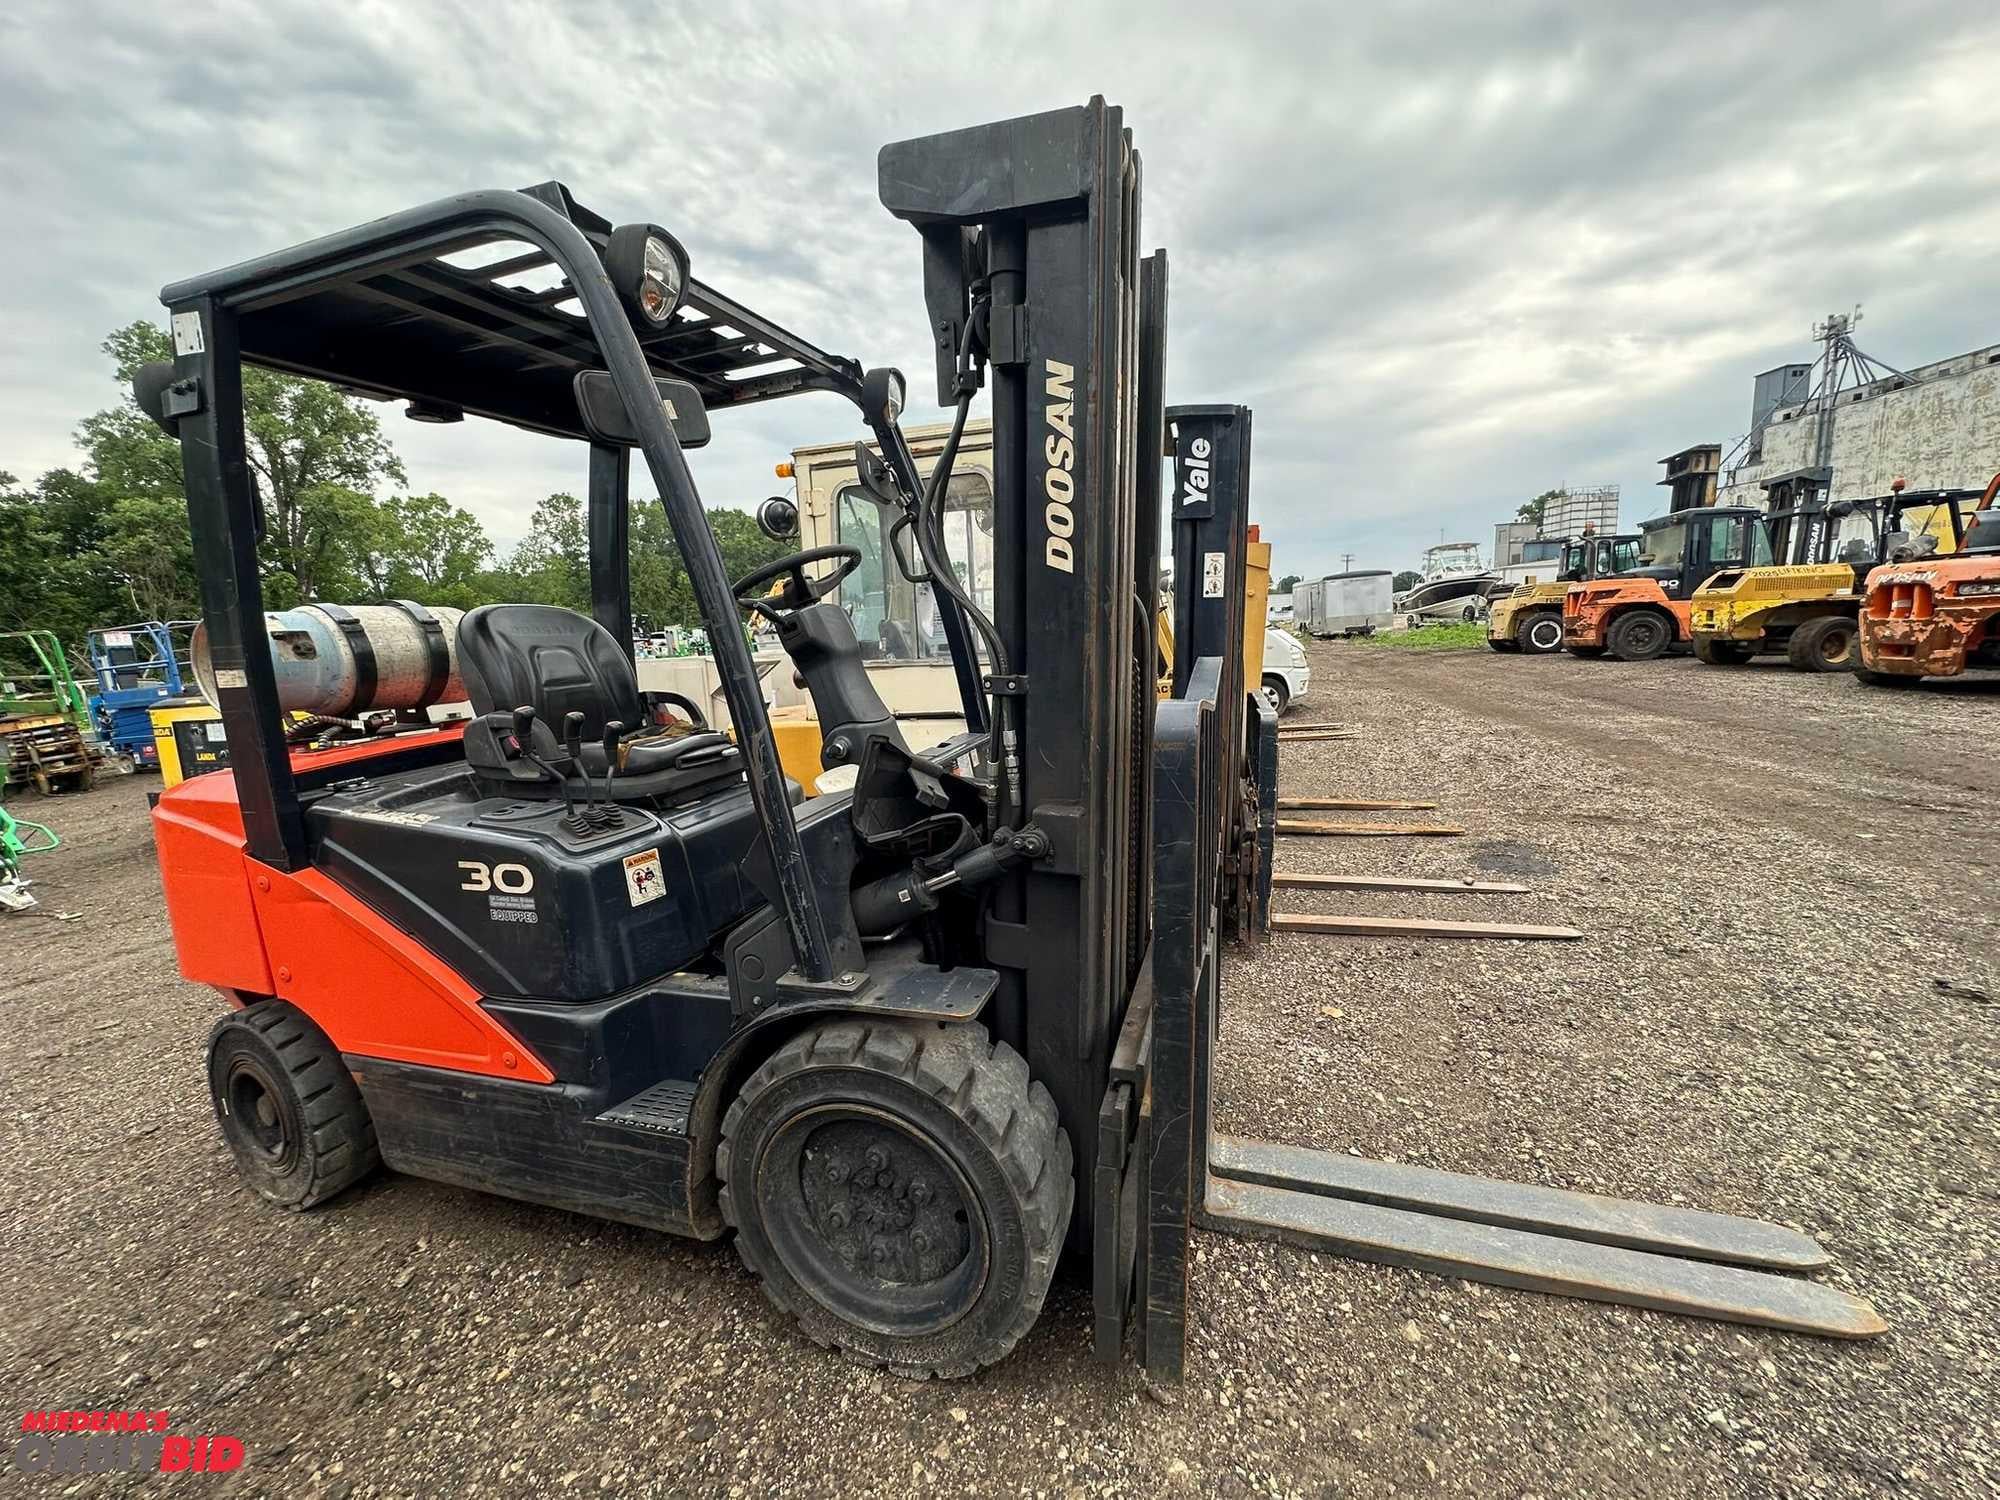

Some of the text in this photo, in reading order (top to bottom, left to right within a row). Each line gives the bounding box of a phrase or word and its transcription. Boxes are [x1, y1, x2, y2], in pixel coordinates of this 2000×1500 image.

[1046, 359, 1075, 574] DOOSAN
[1183, 438, 1211, 506] Yale
[1807, 522, 1820, 566] DOOSAN
[196, 753, 216, 761] LANDA
[458, 861, 534, 894] 30
[489, 908, 539, 924] EQUIPPED
